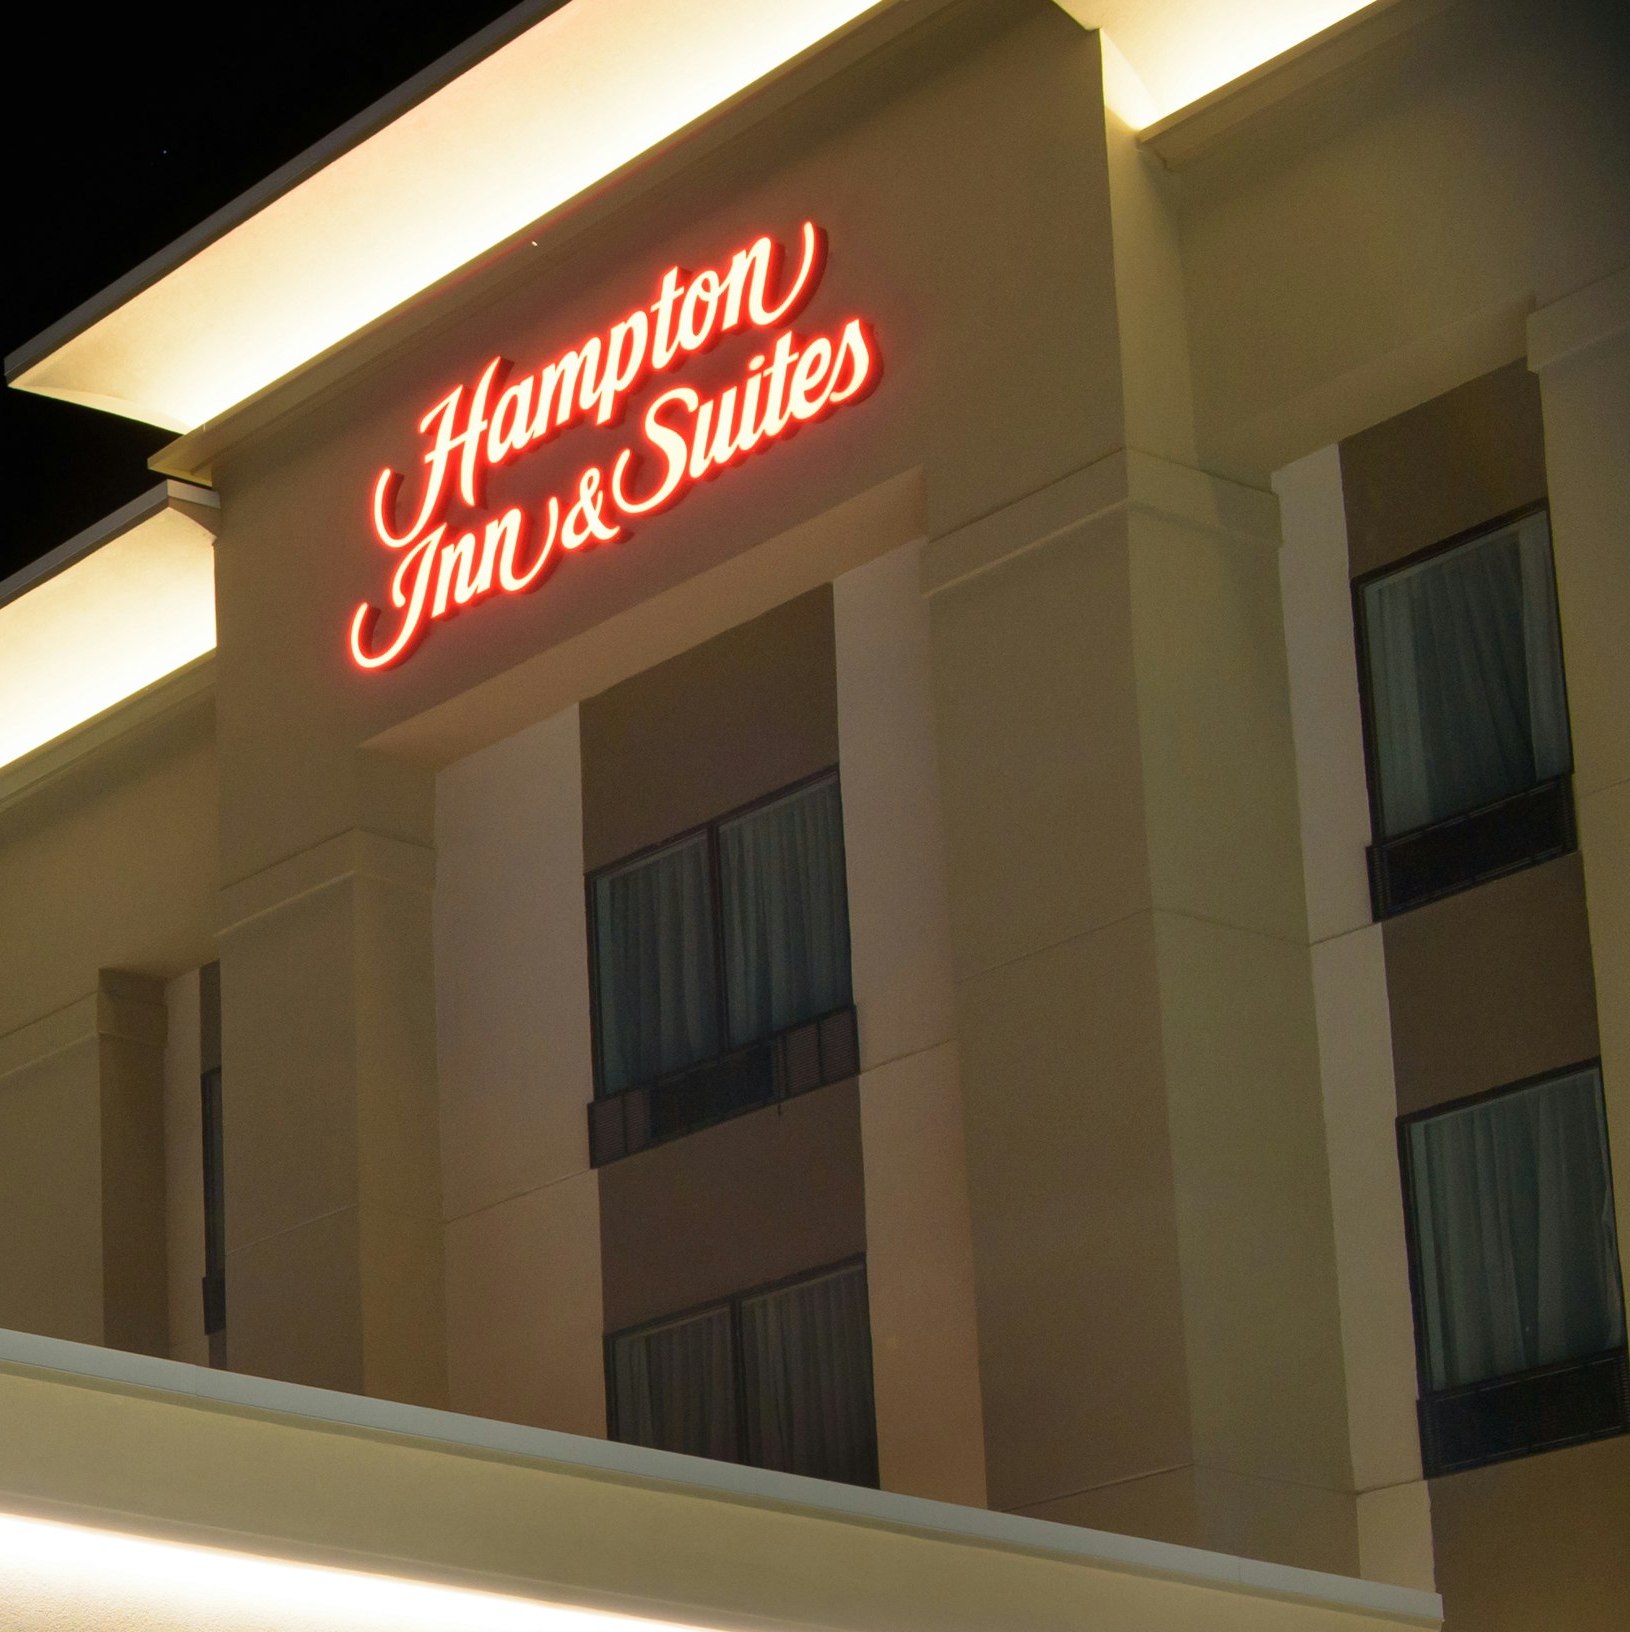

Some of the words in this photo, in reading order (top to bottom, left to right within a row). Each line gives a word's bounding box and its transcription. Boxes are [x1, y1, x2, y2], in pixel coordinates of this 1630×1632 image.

[349, 496, 559, 670] Inn
[561, 467, 621, 552] &
[611, 318, 875, 515] Suites
[373, 220, 823, 549] Hampton
